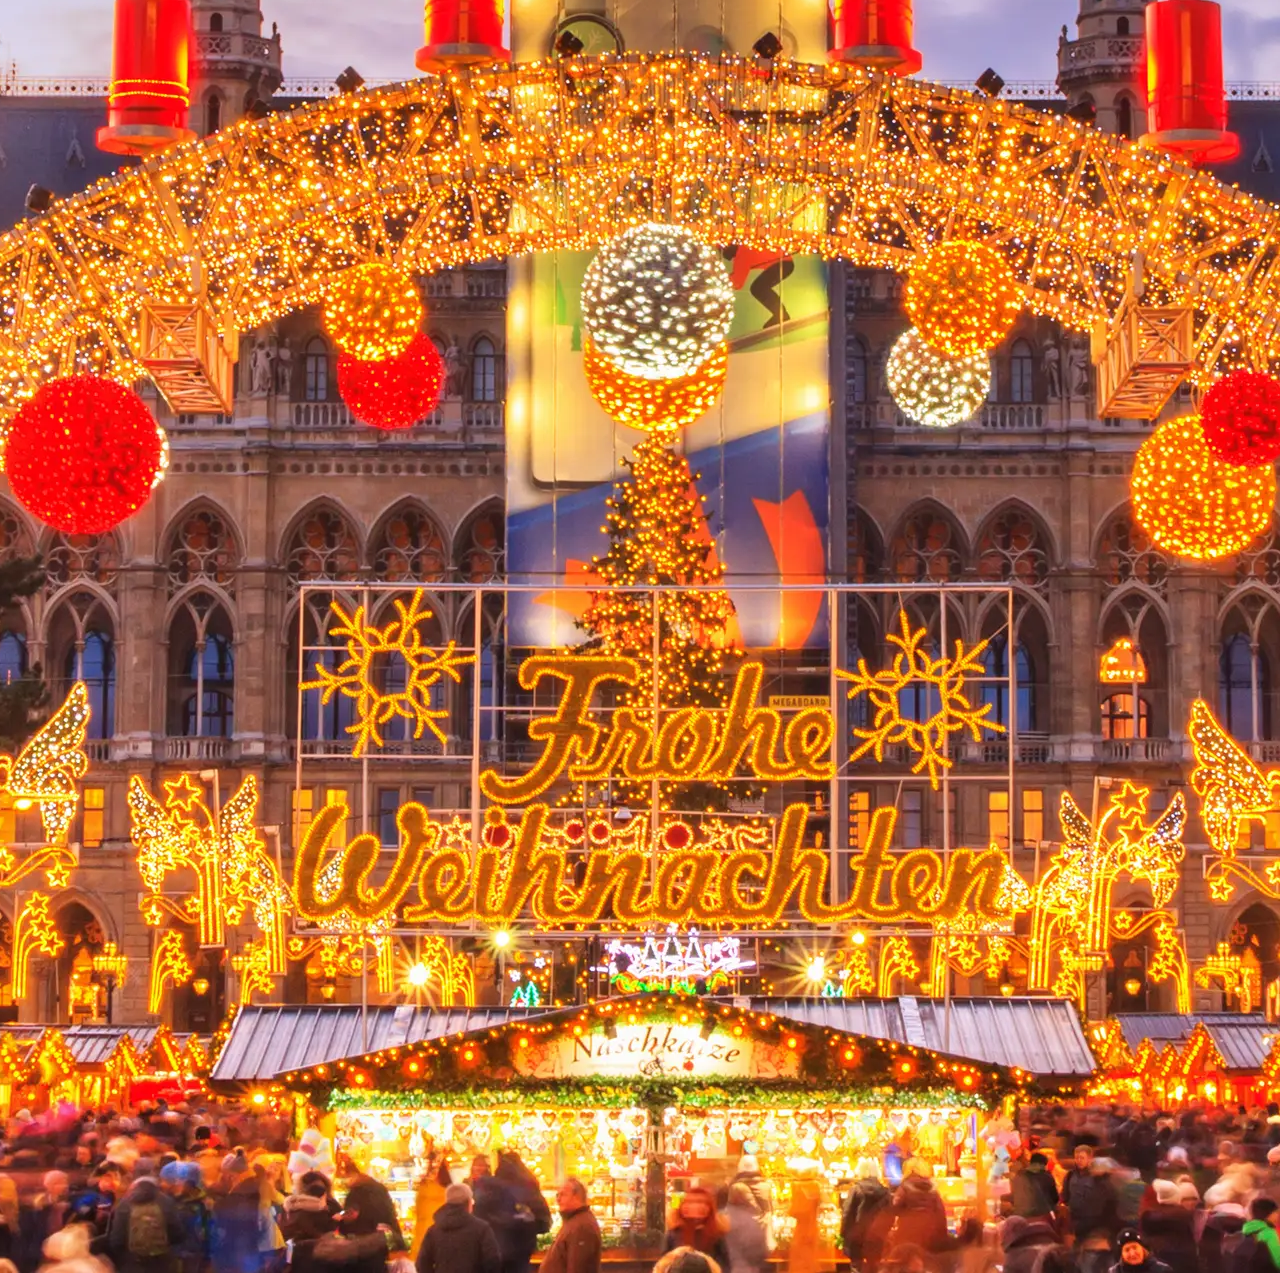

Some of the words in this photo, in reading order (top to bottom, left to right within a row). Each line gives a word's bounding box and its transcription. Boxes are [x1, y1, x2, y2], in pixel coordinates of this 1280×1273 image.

[479, 655, 837, 805] Frohe
[772, 697, 826, 706] MEGABOARD
[293, 802, 1006, 924] Weihnachten
